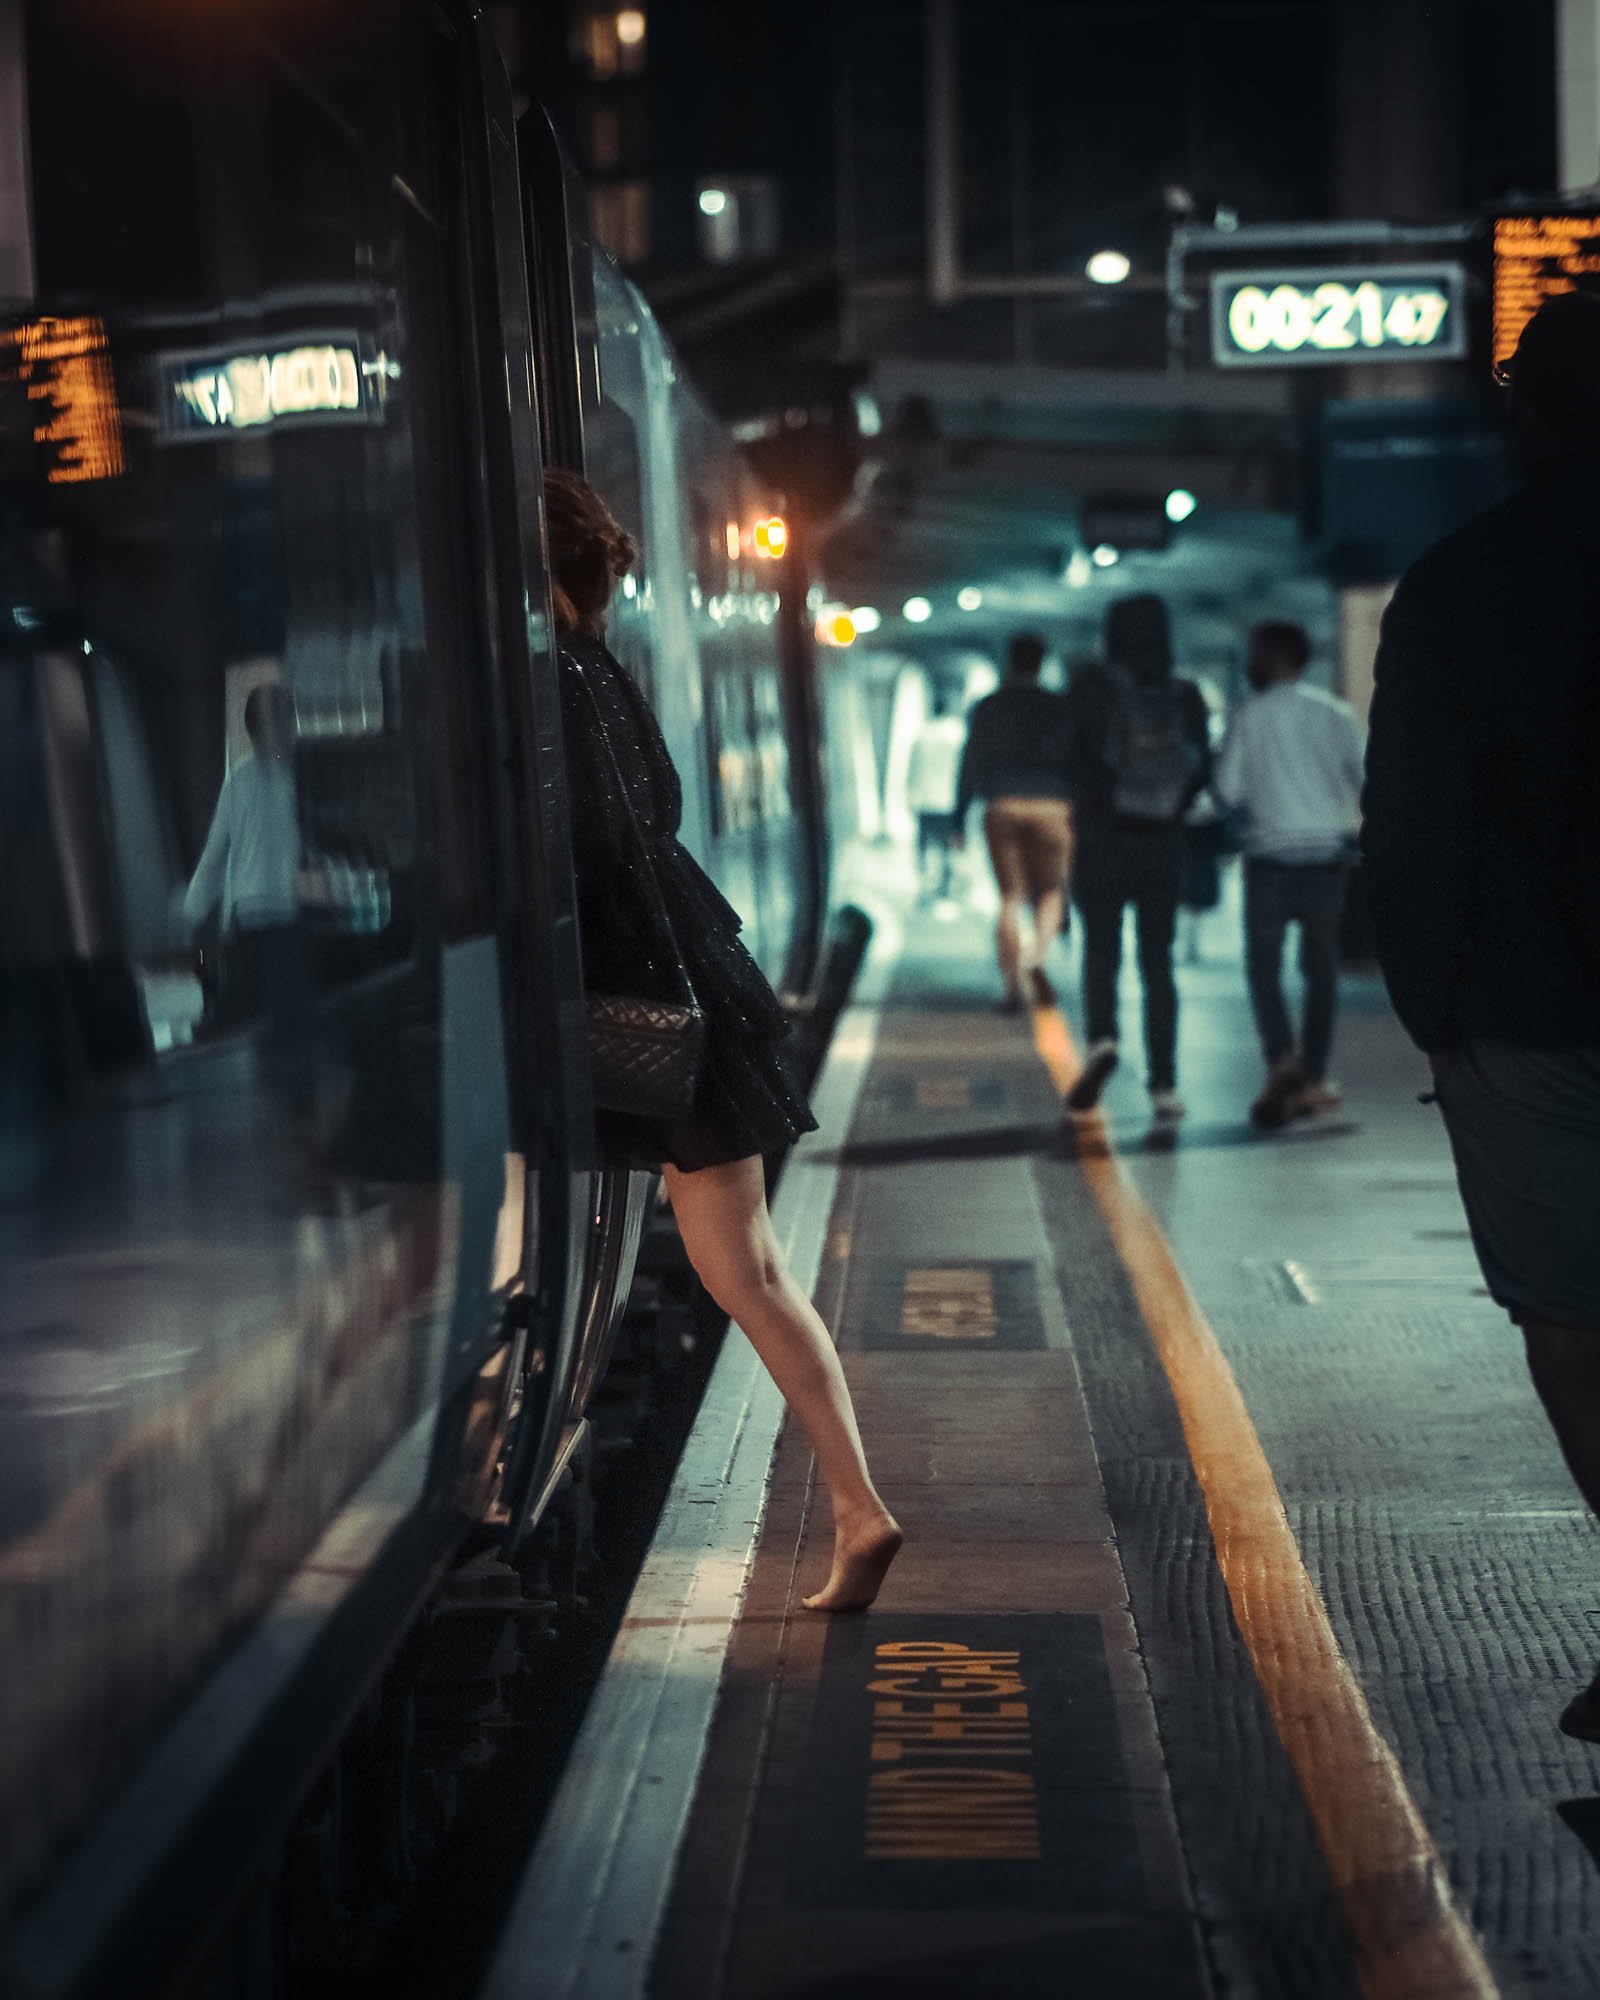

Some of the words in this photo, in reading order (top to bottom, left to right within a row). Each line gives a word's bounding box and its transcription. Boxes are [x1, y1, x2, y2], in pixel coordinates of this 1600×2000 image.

[866, 1640, 1028, 1697] GAP
[870, 1701, 1033, 1761] THE
[864, 1768, 1041, 1860] MIND
